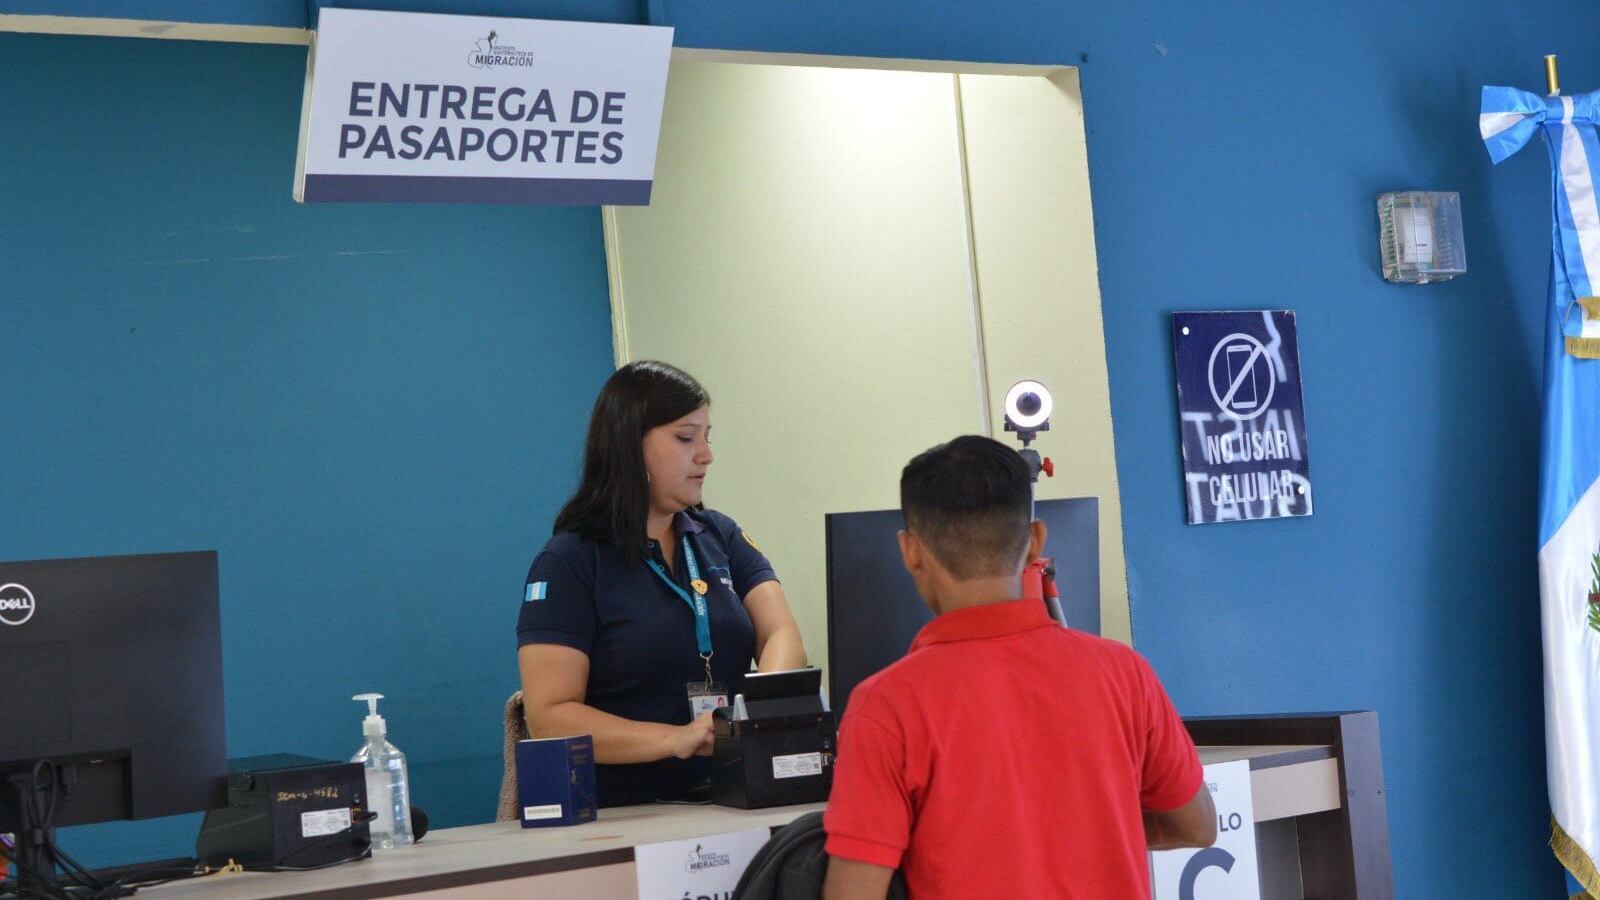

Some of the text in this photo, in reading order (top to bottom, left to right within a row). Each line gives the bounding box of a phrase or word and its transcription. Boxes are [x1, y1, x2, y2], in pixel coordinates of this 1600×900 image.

[348, 81, 626, 125] ENTREGA DE
[337, 123, 625, 164] PASAPORTES
[1207, 429, 1290, 465] NO USAR
[1209, 469, 1295, 506] CELULAR
[0, 598, 31, 610] DELL
